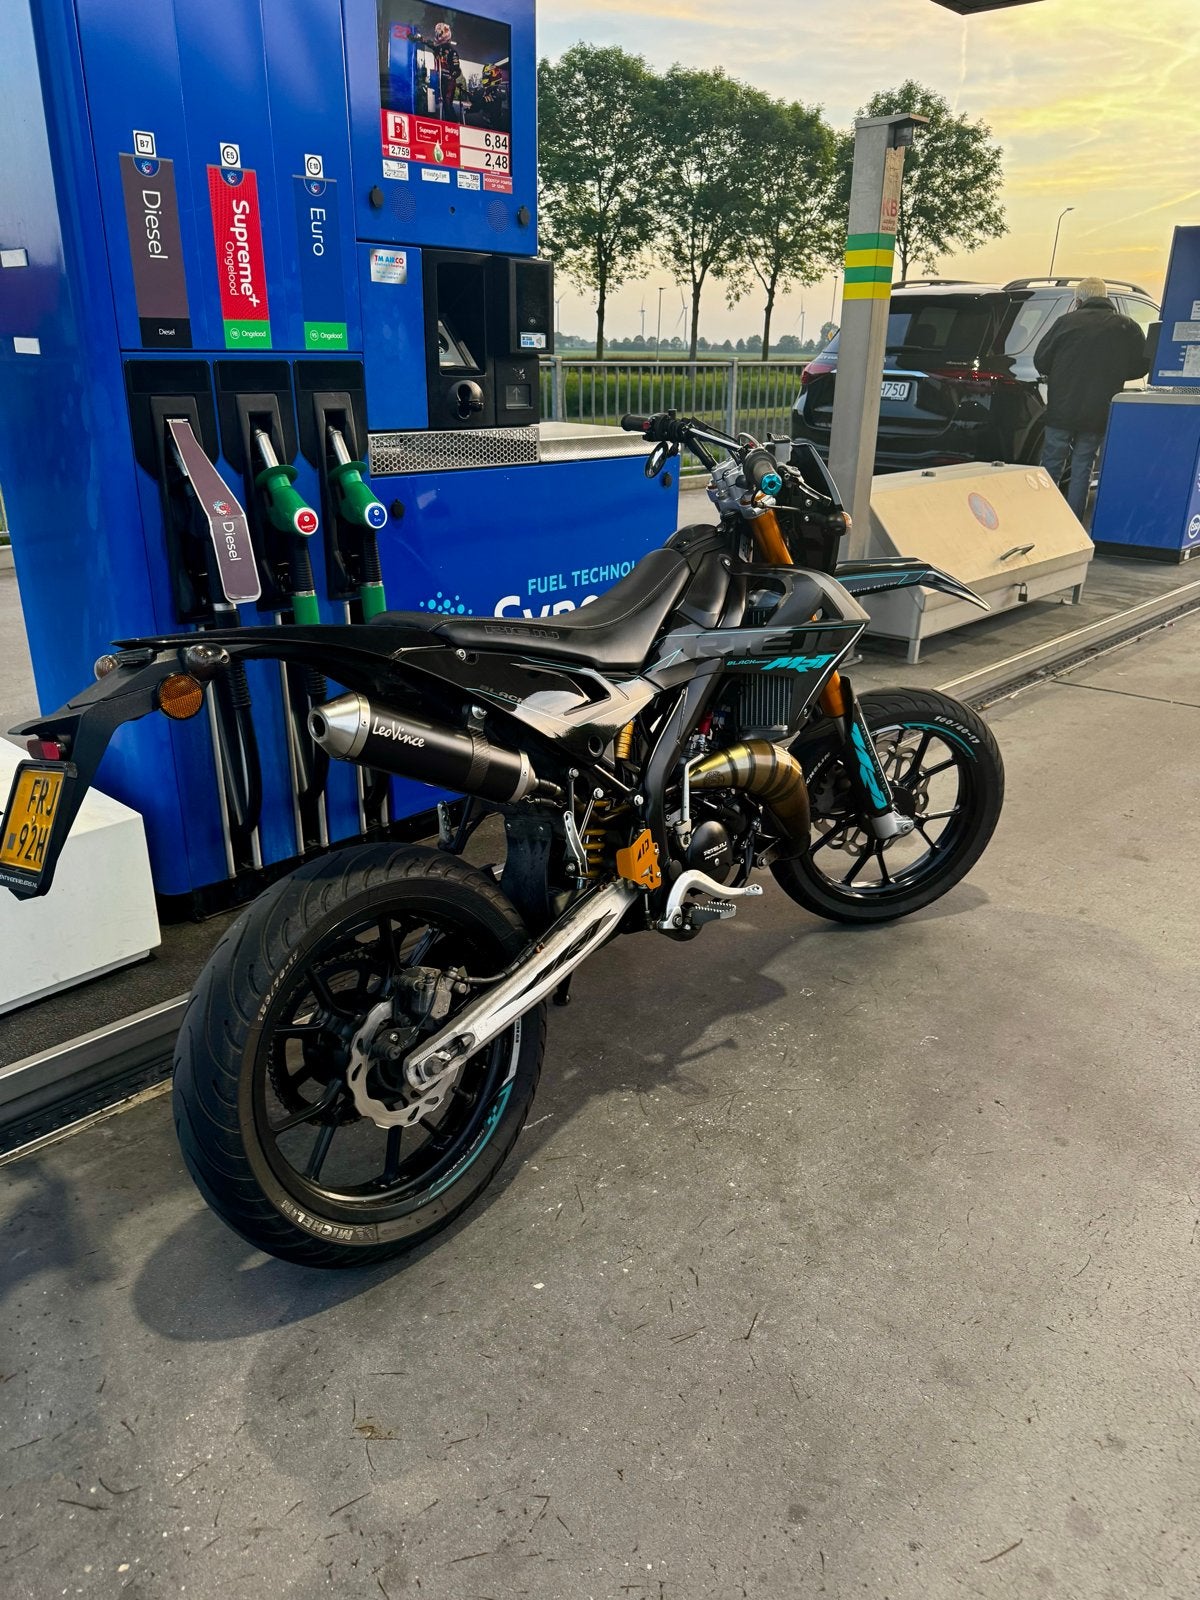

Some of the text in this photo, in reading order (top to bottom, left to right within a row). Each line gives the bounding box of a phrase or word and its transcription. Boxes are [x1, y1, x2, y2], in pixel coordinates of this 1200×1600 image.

[139, 139, 150, 149] B7
[226, 151, 235, 159] E5
[391, 145, 410, 157] 2,759
[484, 133, 508, 150] 6,84
[484, 152, 508, 170] 2,48
[142, 190, 168, 259] Diesel
[310, 207, 326, 256] Euro
[224, 241, 239, 296] Ongelood
[230, 199, 260, 307] Supreme+
[158, 328, 176, 336] Diesel
[222, 521, 242, 561] Diesel
[528, 573, 567, 596] FUEL
[372, 716, 425, 748] LeoVince
[27, 778, 61, 816] FRJ
[17, 823, 49, 863] 92H
[280, 1199, 354, 1241] MICHELIN
